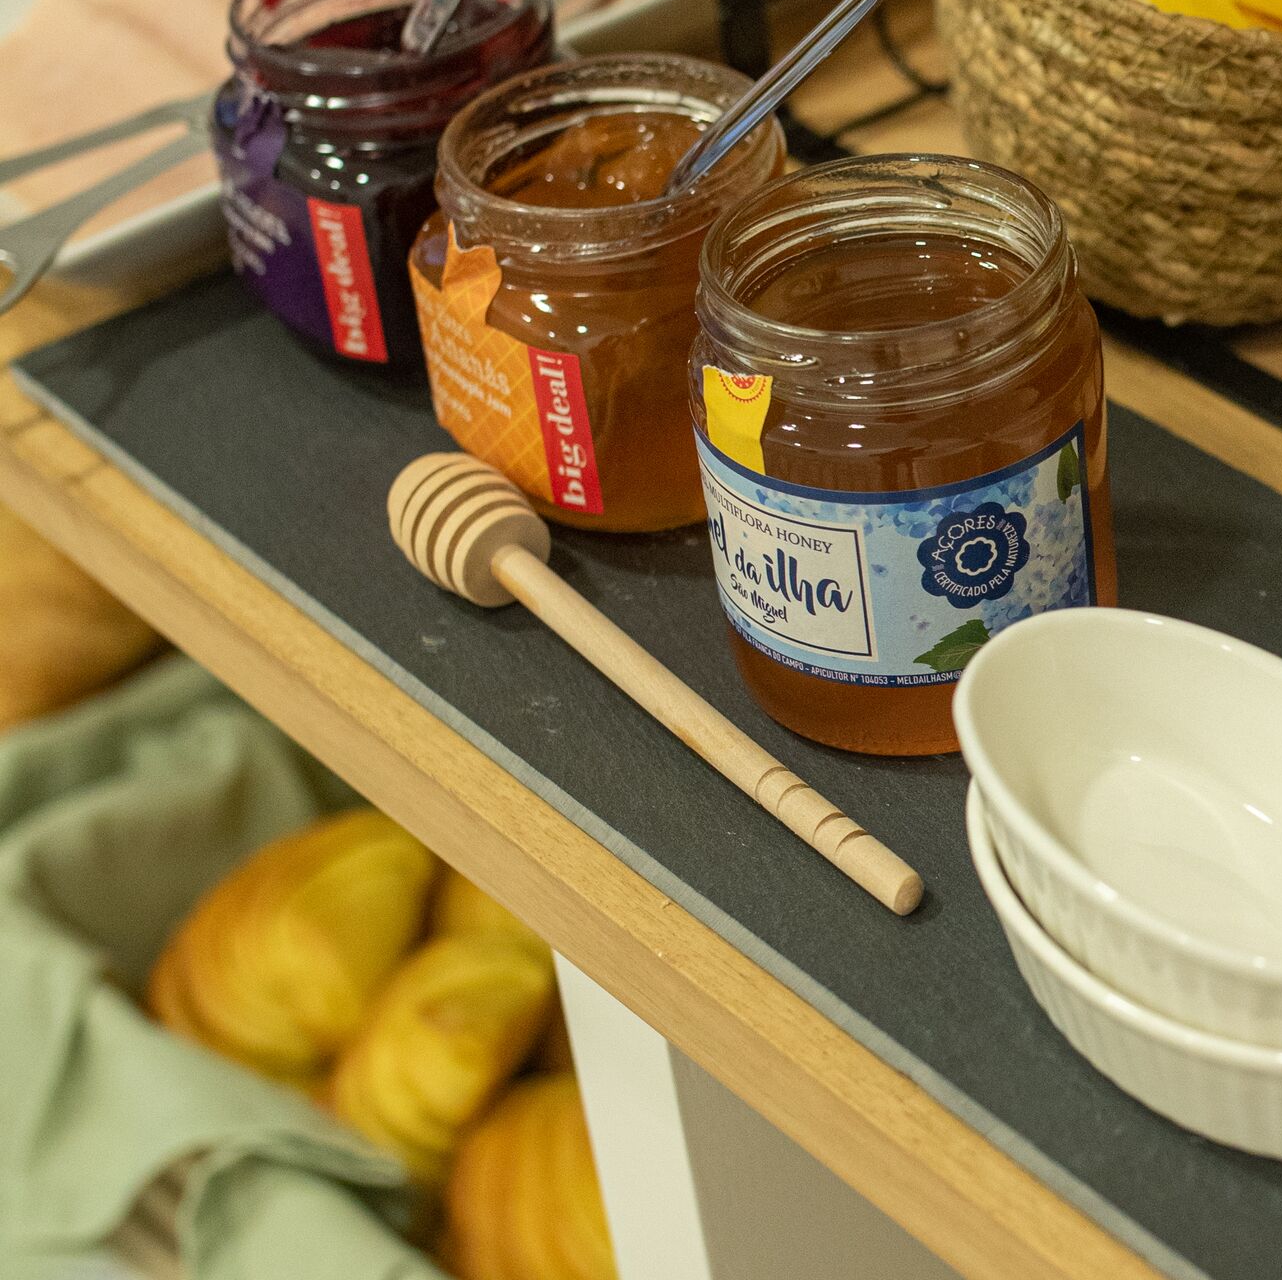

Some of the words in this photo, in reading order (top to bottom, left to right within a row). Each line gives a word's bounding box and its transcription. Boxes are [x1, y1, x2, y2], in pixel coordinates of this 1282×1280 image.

[536, 353, 575, 437] deal!
[558, 439, 588, 507] big
[776, 526, 833, 555] HONEY
[931, 515, 996, 563] AÇORES
[934, 571, 988, 597] CERTIFICADO
[988, 568, 1012, 589] PELA
[1002, 522, 1019, 567] NATUREZA
[735, 546, 762, 586] da
[763, 547, 854, 616] ilha
[750, 589, 789, 624] Miguel
[782, 656, 804, 671] CAMPO
[811, 666, 849, 682] APICULTOR
[861, 674, 889, 685] 104053
[896, 670, 963, 685] MELDAILHASM@
